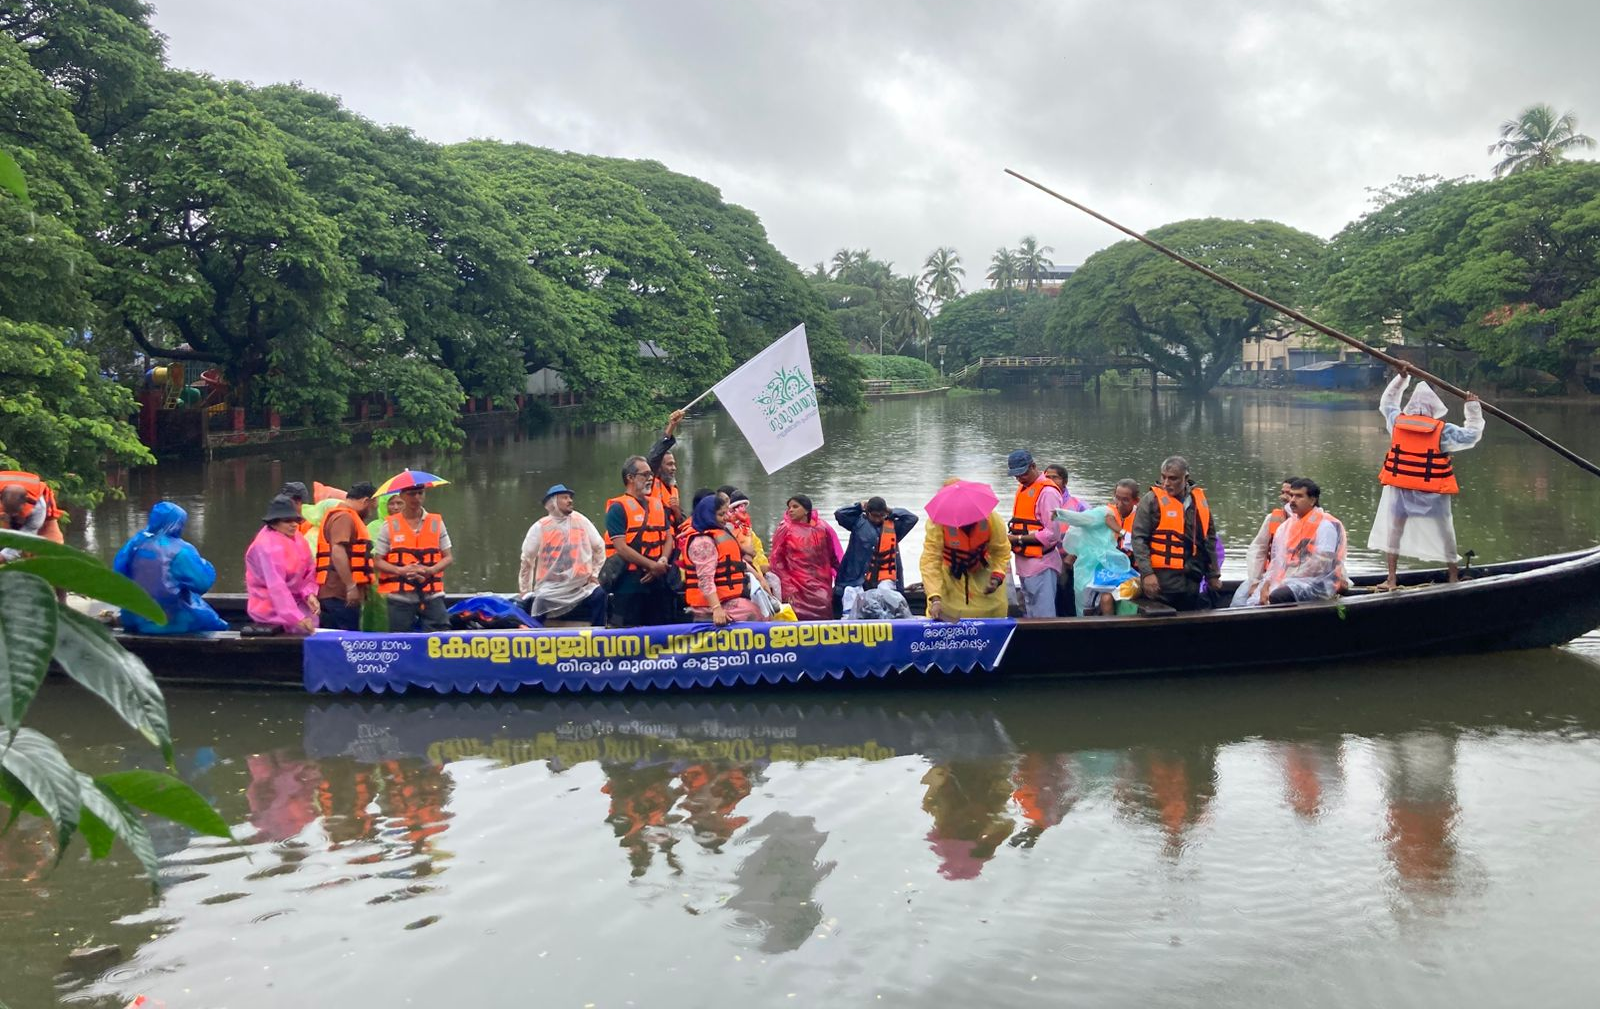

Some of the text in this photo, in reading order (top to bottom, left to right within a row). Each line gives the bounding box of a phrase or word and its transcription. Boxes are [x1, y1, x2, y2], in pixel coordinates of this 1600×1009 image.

[427, 636, 511, 663] കേരള
[556, 650, 798, 675] തിരൂർ മുതൽ കൂട്ടായി വരെ
